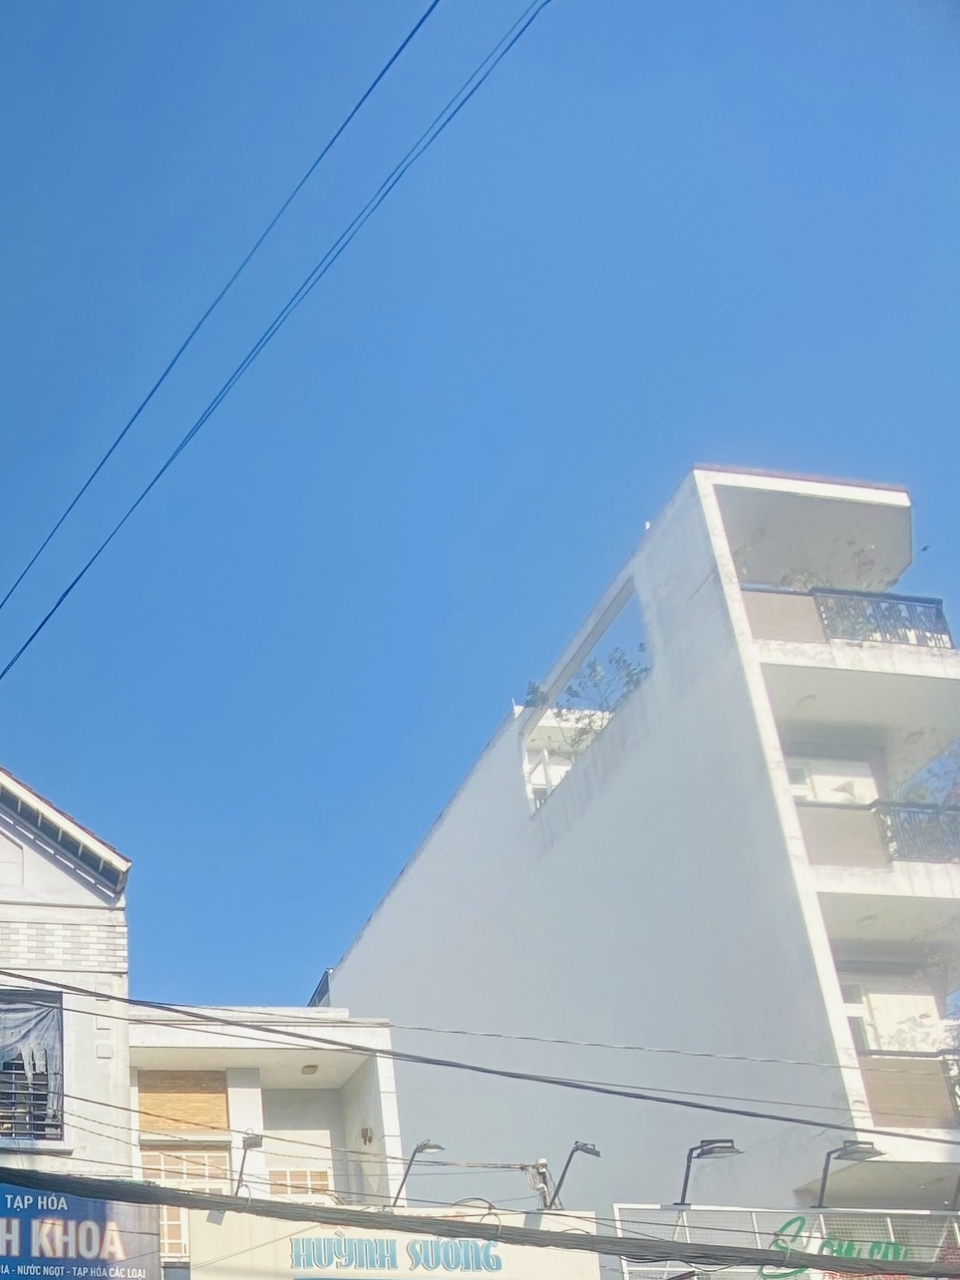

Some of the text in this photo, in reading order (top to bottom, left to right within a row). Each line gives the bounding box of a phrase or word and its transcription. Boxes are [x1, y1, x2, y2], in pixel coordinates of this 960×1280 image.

[5, 1193, 68, 1212] TẠP HÓA
[30, 1219, 127, 1261] KHOA
[290, 1231, 398, 1271] HUỲNH
[17, 1264, 41, 1276] NƯỚC
[42, 1266, 65, 1279] NGỌT
[72, 1267, 89, 1279] TẠP
[90, 1266, 108, 1278] HÓA
[109, 1266, 126, 1279] CÁC
[127, 1268, 146, 1280] LOẠI
